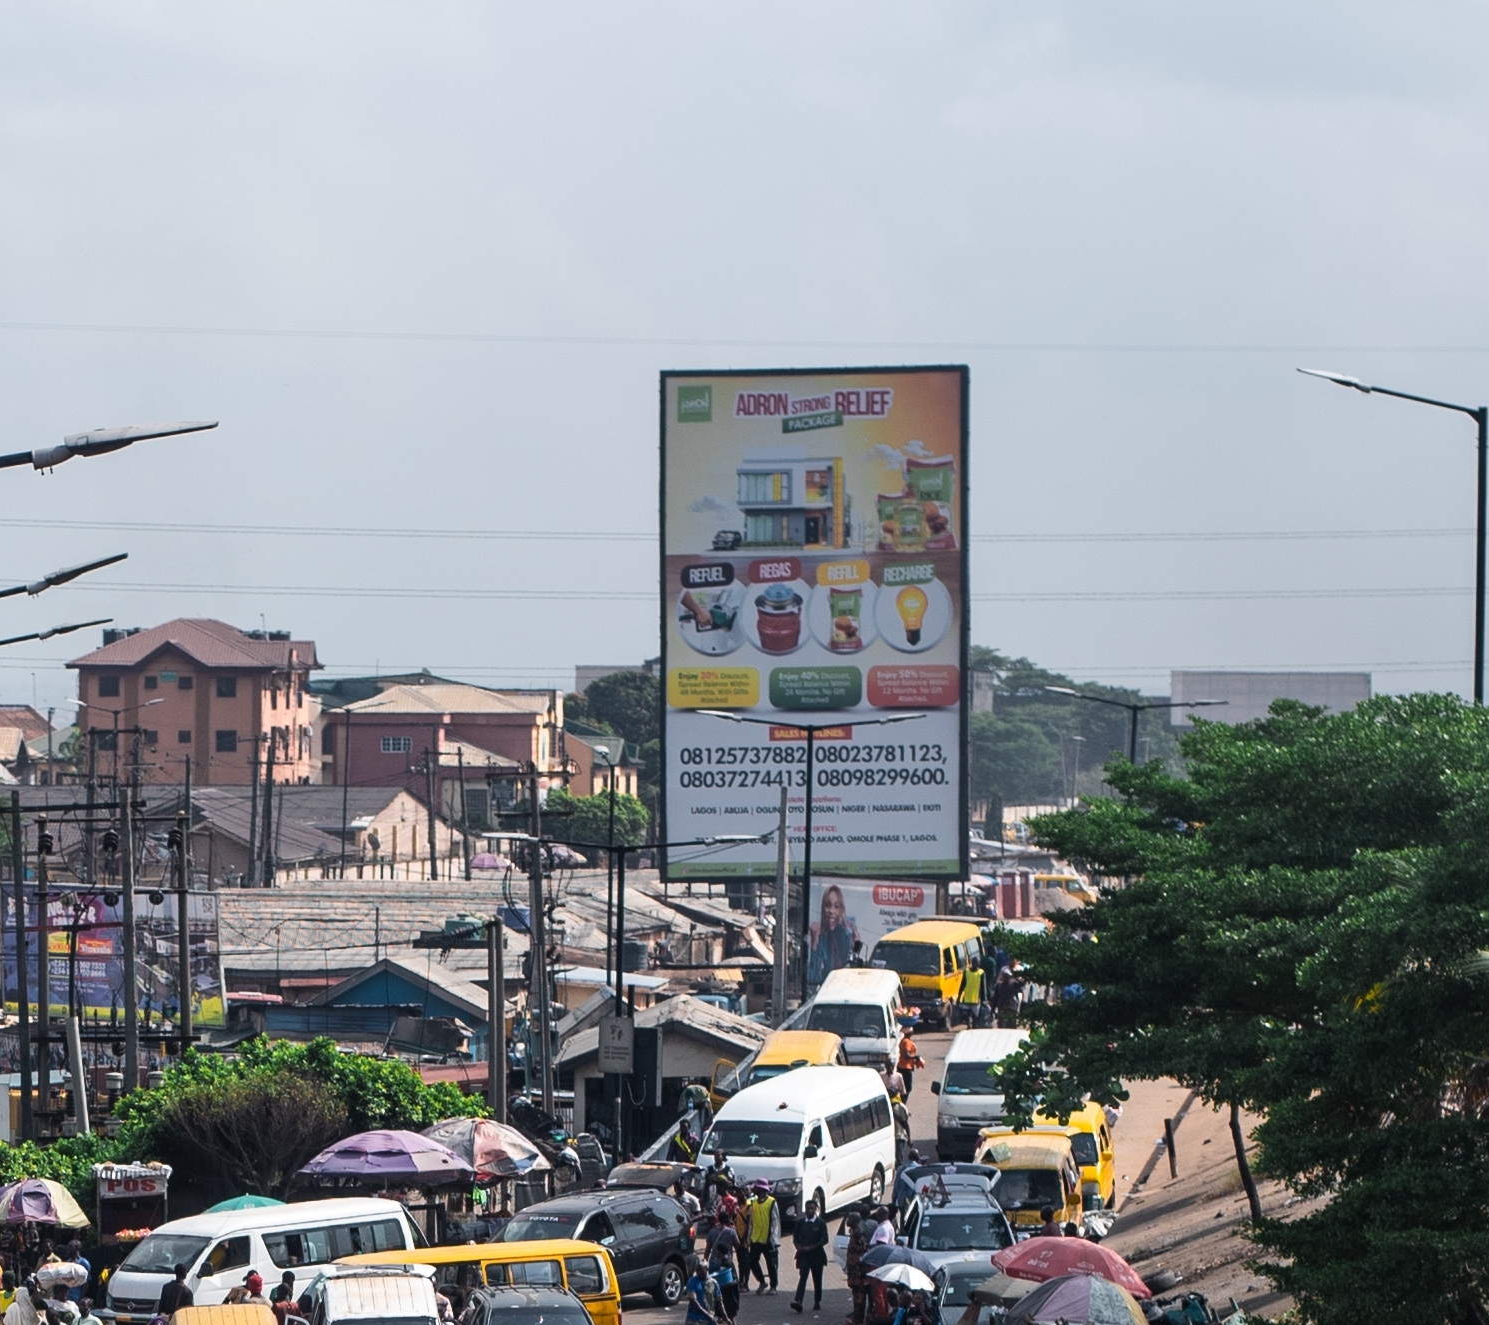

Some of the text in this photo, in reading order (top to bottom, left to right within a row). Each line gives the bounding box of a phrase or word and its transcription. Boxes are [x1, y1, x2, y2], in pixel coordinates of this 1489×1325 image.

[736, 393, 788, 416] ADRON
[792, 396, 831, 414] STRONG
[835, 391, 891, 416] RELIEF
[788, 415, 837, 430] PACKAGE
[689, 567, 726, 583] REFUEL
[759, 563, 792, 578] REGAS
[827, 566, 861, 580] REFILL
[883, 565, 935, 583] RECHARGE
[814, 744, 947, 765] 08023781123,
[817, 768, 949, 787] 08098299600.
[690, 806, 717, 814] LAGOS
[842, 803, 866, 812] NIGER
[872, 802, 916, 812] NASARAWA
[876, 835, 899, 844] PHASE
[878, 886, 918, 902] IBUCAP
[107, 1178, 156, 1193] POS
